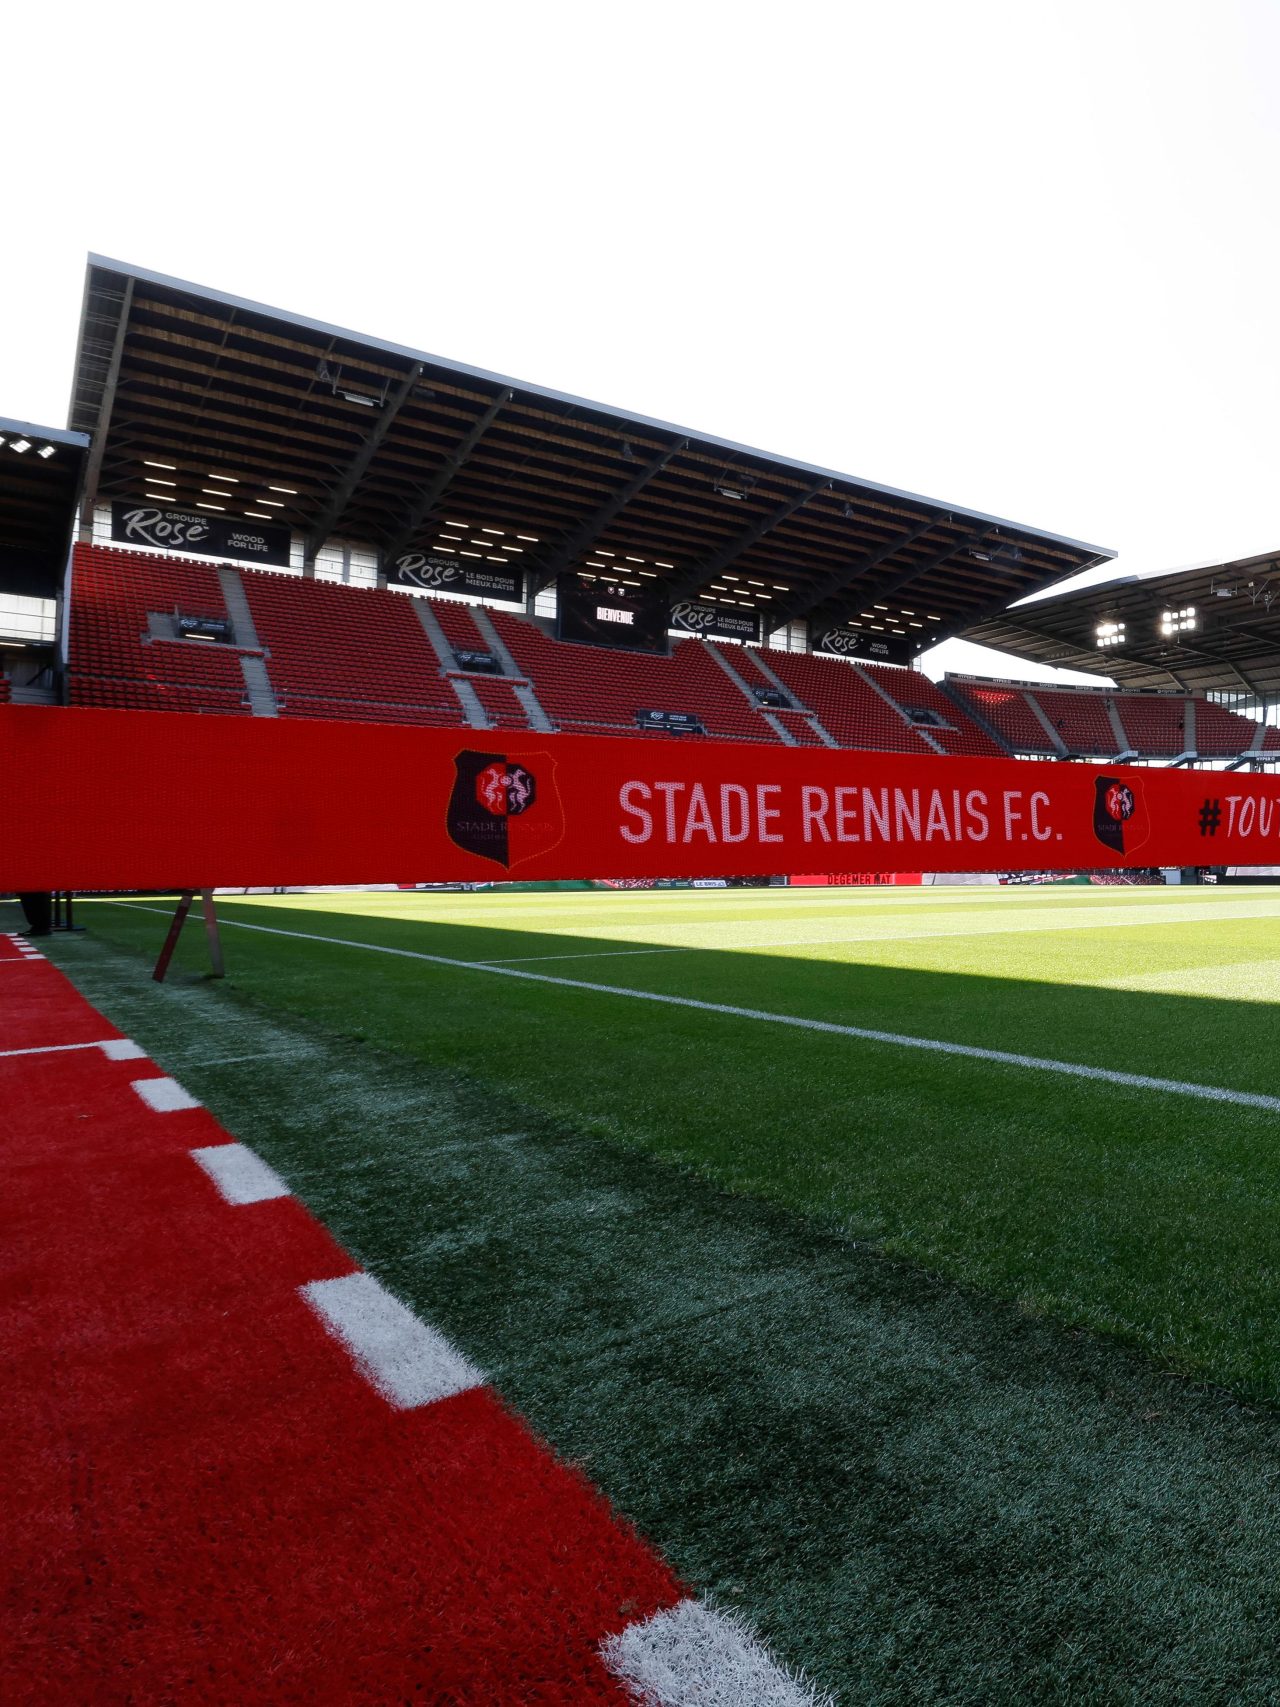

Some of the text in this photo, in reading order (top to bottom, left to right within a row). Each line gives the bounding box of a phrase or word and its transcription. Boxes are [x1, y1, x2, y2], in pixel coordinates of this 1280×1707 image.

[165, 512, 208, 526] GROUPE
[232, 533, 265, 544] WOOD
[228, 539, 268, 552] FOR LIFE
[428, 556, 460, 568] GROUPE
[466, 578, 514, 592] MIEUX BÂTIR
[476, 573, 494, 582] BOIS
[496, 576, 514, 585] POUR
[596, 607, 634, 625] BIENVENUE
[619, 780, 1063, 844] STADE RENNAIS F.C.
[828, 874, 871, 886] DEGEMER
